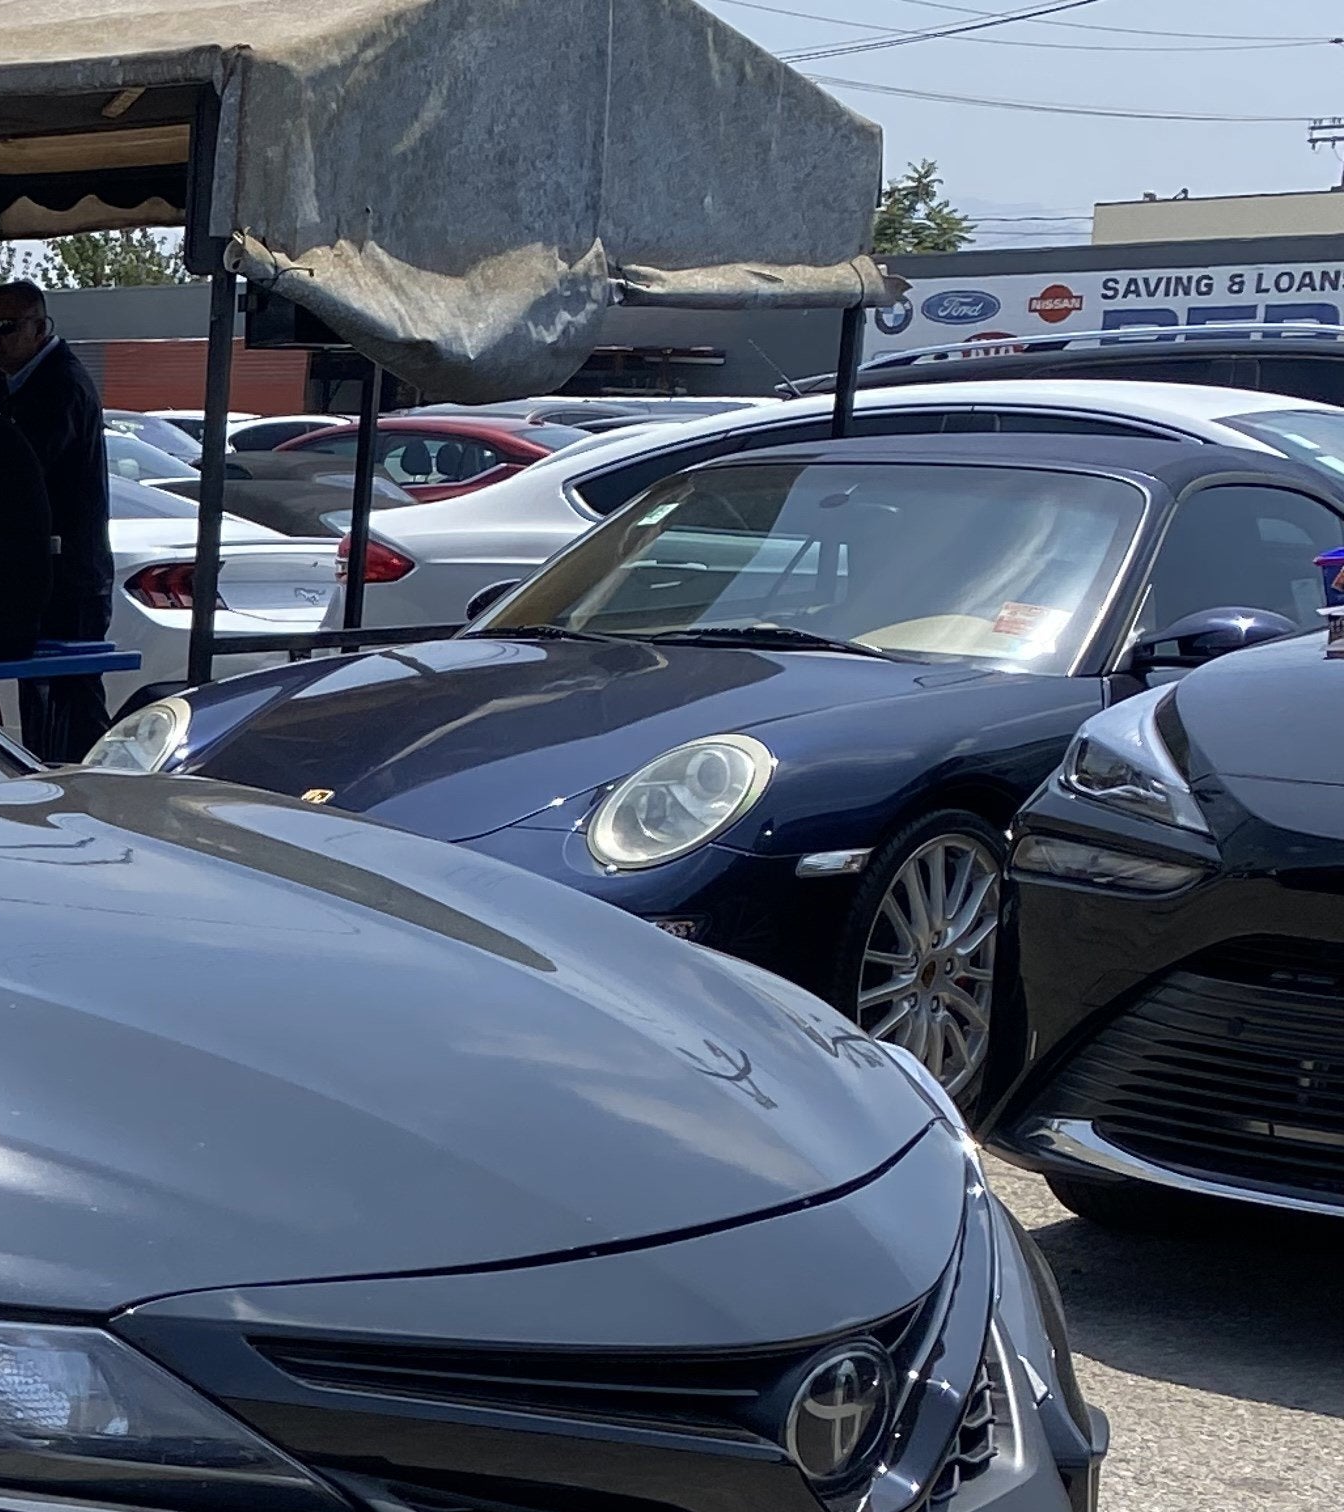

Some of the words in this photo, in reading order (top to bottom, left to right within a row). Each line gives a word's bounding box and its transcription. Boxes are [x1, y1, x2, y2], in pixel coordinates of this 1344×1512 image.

[1100, 274, 1214, 301] SAVING
[1226, 273, 1246, 295] &
[1254, 270, 1344, 293] LOAN
[937, 295, 983, 318] Ford
[1031, 297, 1081, 310] NISSAN
